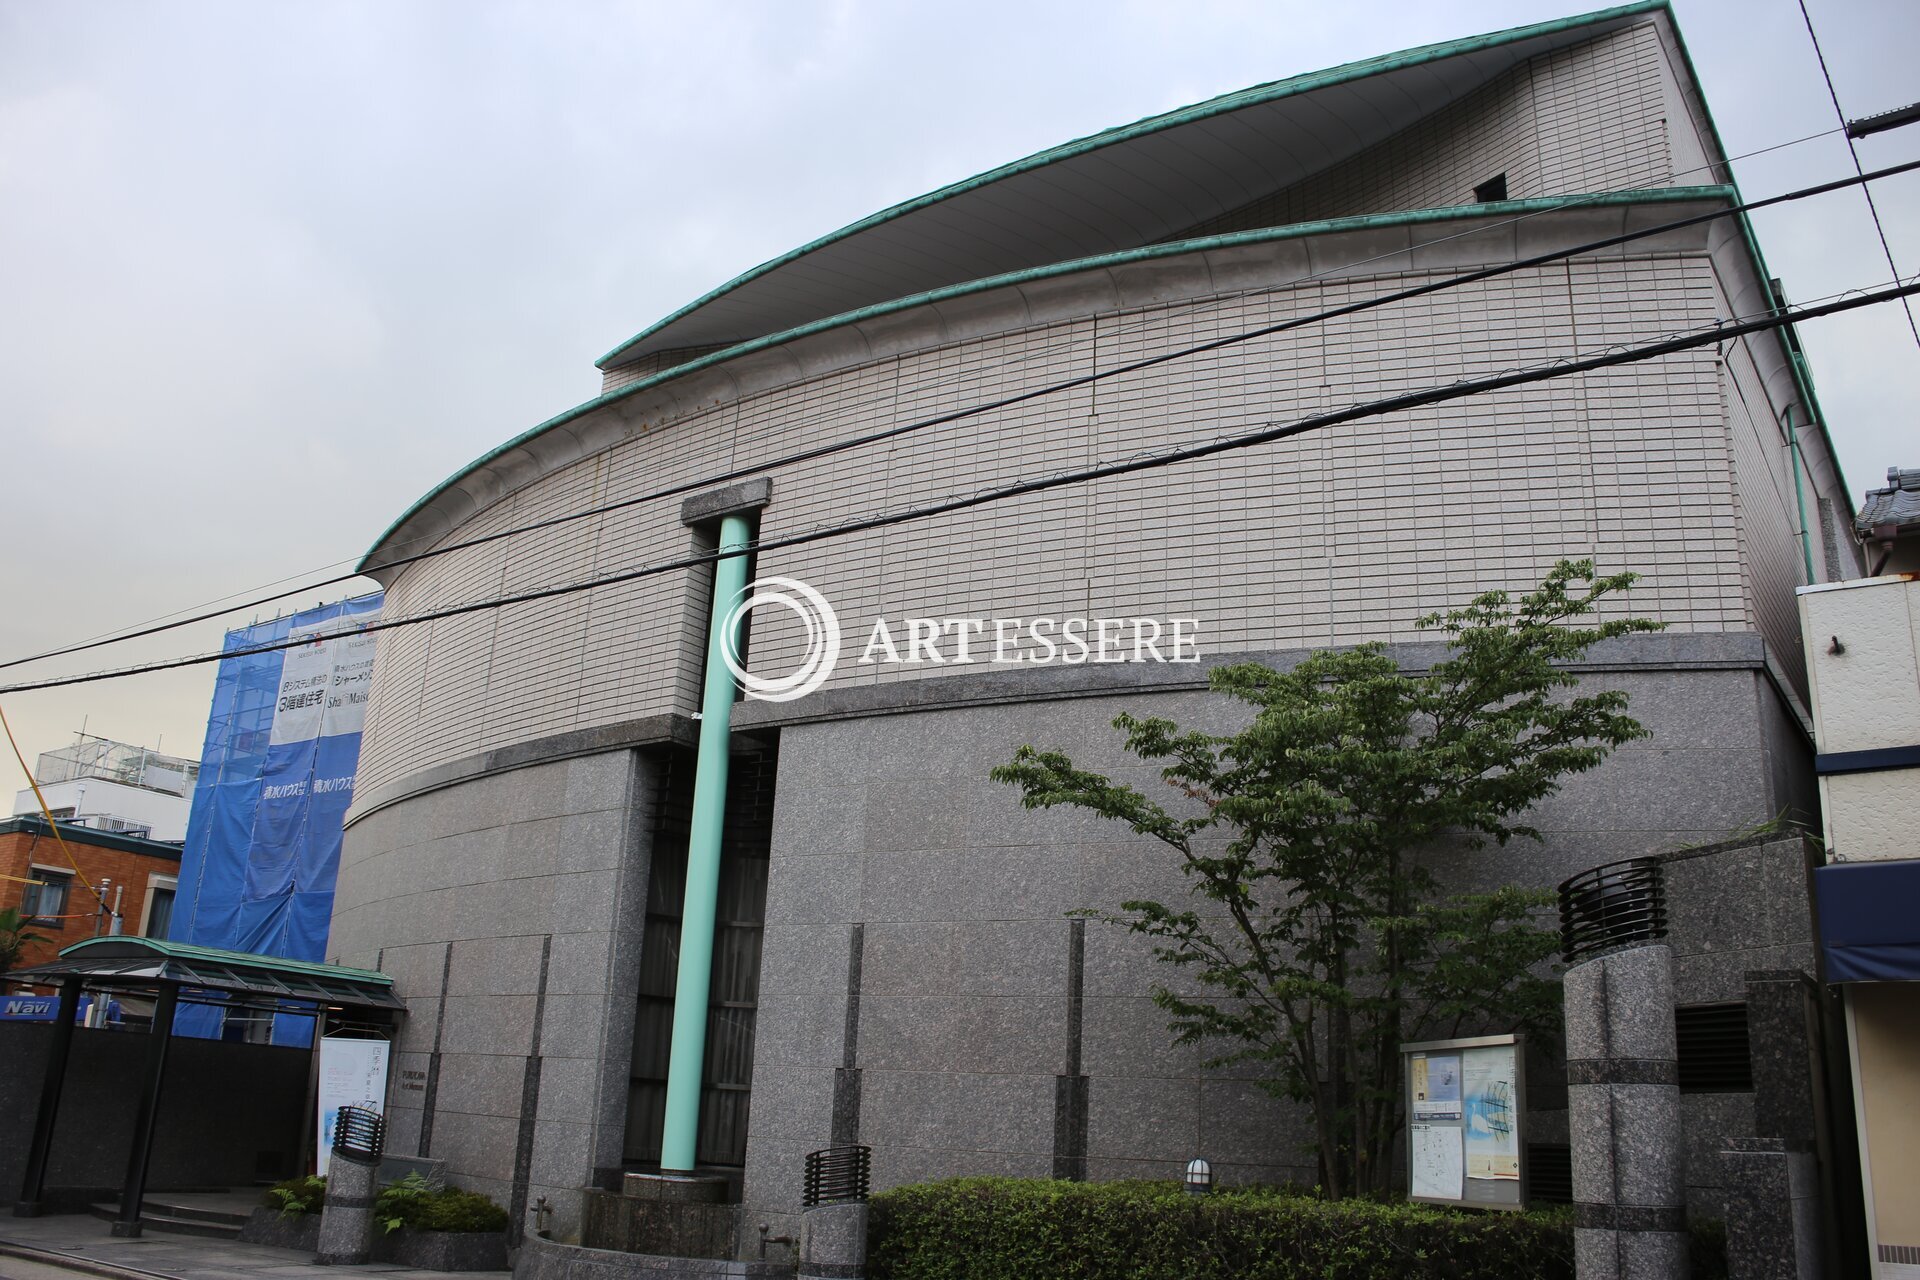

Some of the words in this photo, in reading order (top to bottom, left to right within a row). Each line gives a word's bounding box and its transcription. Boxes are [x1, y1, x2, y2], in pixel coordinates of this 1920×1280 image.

[279, 689, 325, 712] 3階建住宅
[4, 1000, 51, 1014] Navi
